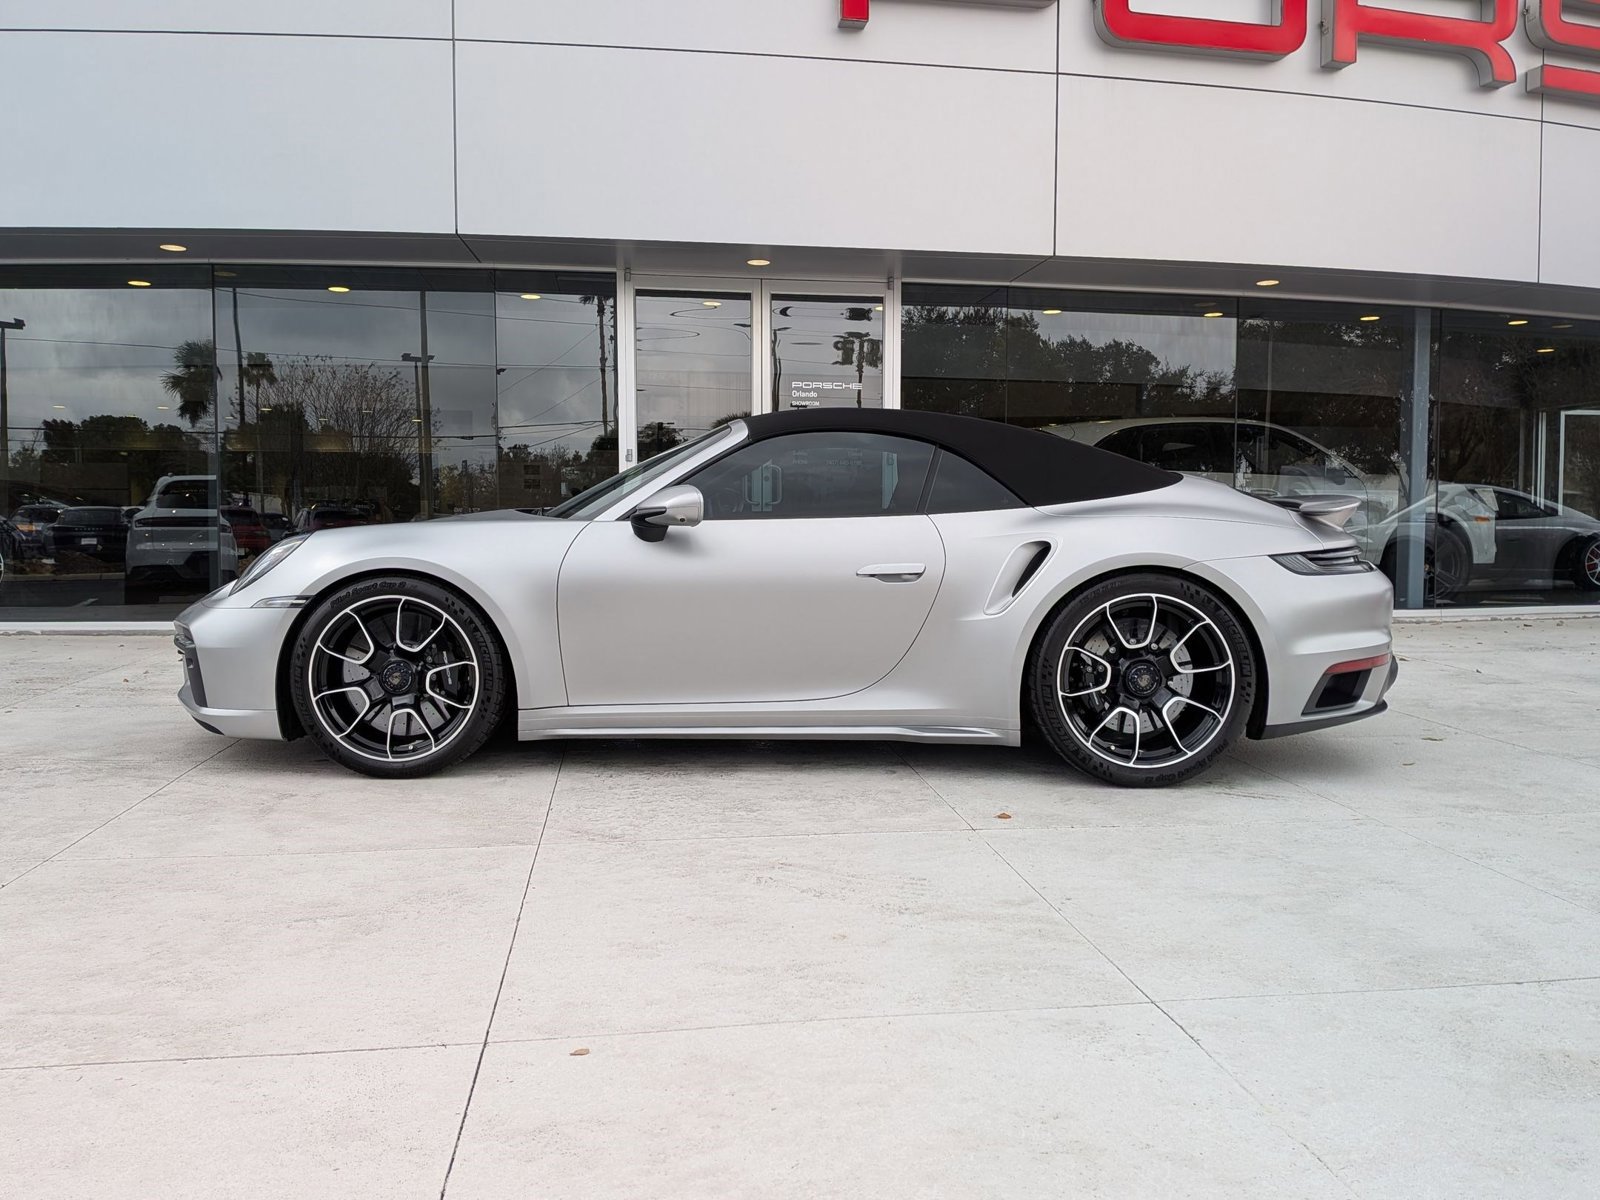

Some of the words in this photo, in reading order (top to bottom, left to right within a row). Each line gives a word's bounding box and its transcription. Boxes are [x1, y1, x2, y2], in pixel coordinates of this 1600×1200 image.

[791, 381, 863, 390] PORSCHE
[791, 390, 818, 398] Orlando
[330, 591, 351, 608] Pilot
[352, 583, 378, 595] Sport
[379, 581, 397, 589] Cup
[1216, 609, 1253, 677] MICHELIN
[473, 631, 493, 691] MICHELIN
